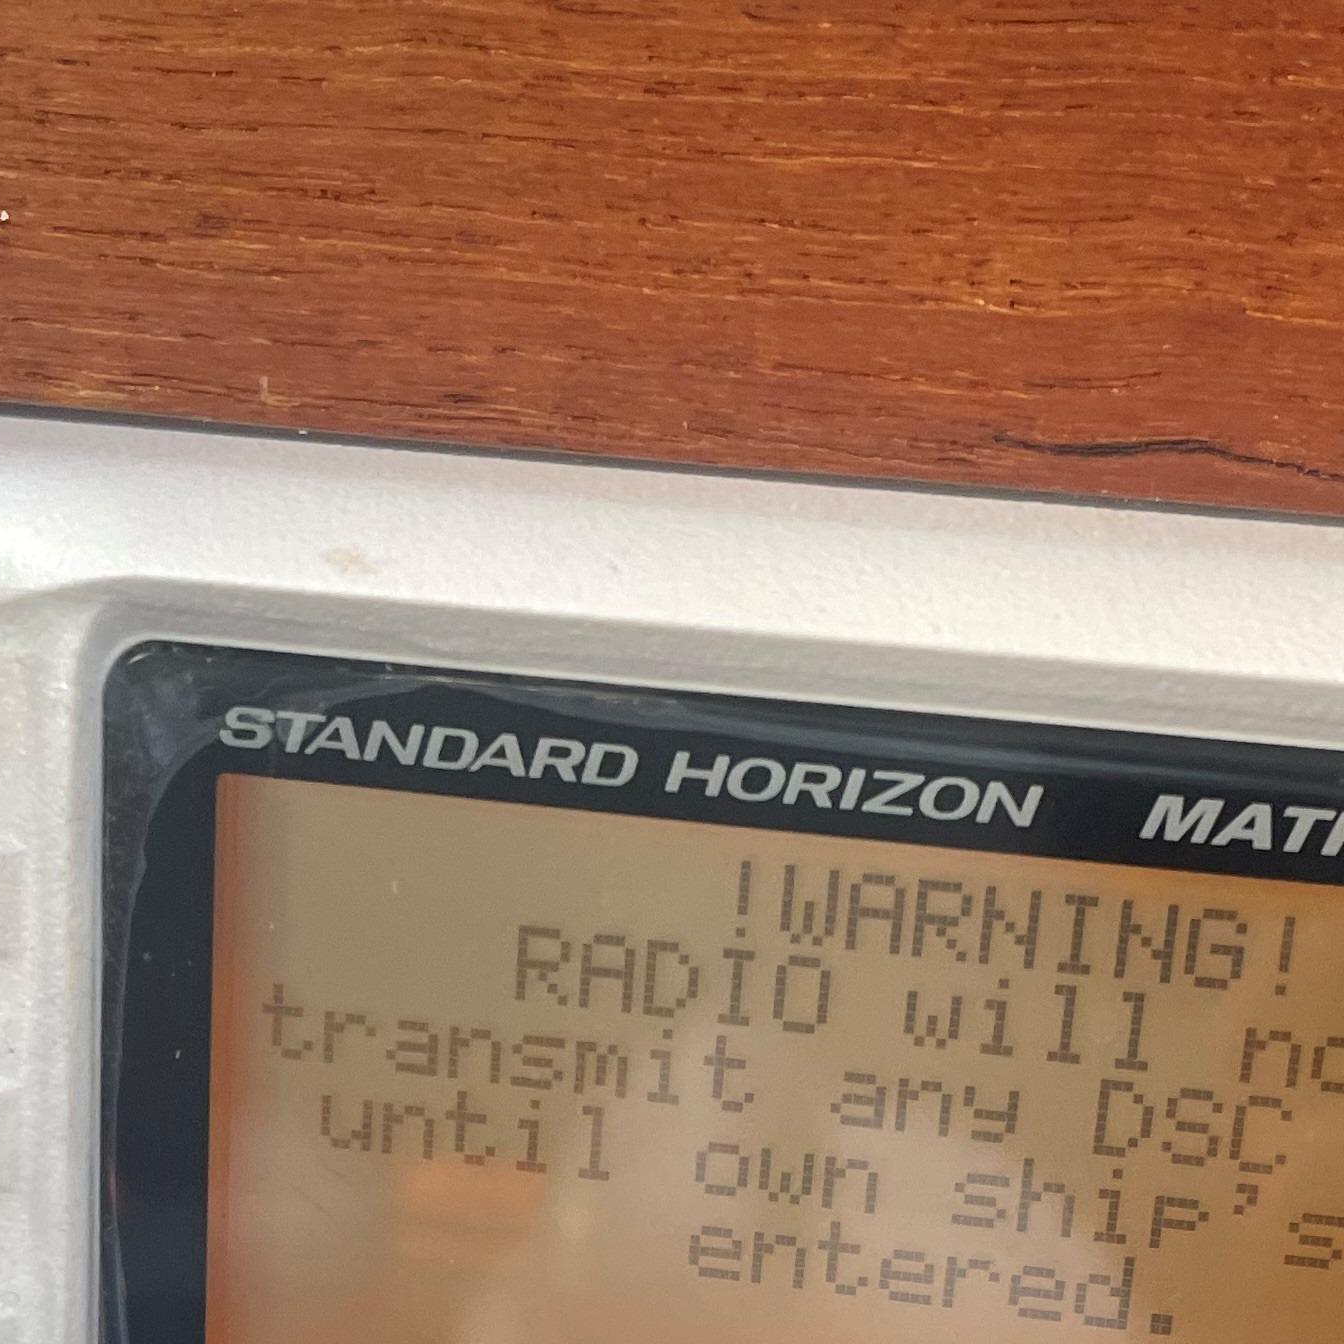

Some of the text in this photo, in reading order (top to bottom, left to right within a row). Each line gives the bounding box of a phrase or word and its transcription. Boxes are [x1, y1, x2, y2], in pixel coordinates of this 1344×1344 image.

[218, 705, 1044, 828] STANDARD HORIZON
[735, 859, 1297, 996] !WARNING!
[514, 924, 831, 1035] RADIO
[902, 977, 1149, 1073] will
[261, 982, 756, 1113] transmit
[830, 1070, 1021, 1143] any
[1092, 1078, 1294, 1176] DSC
[319, 1090, 611, 1181] until
[694, 1141, 879, 1214] own
[687, 1221, 1175, 1336] entered.
